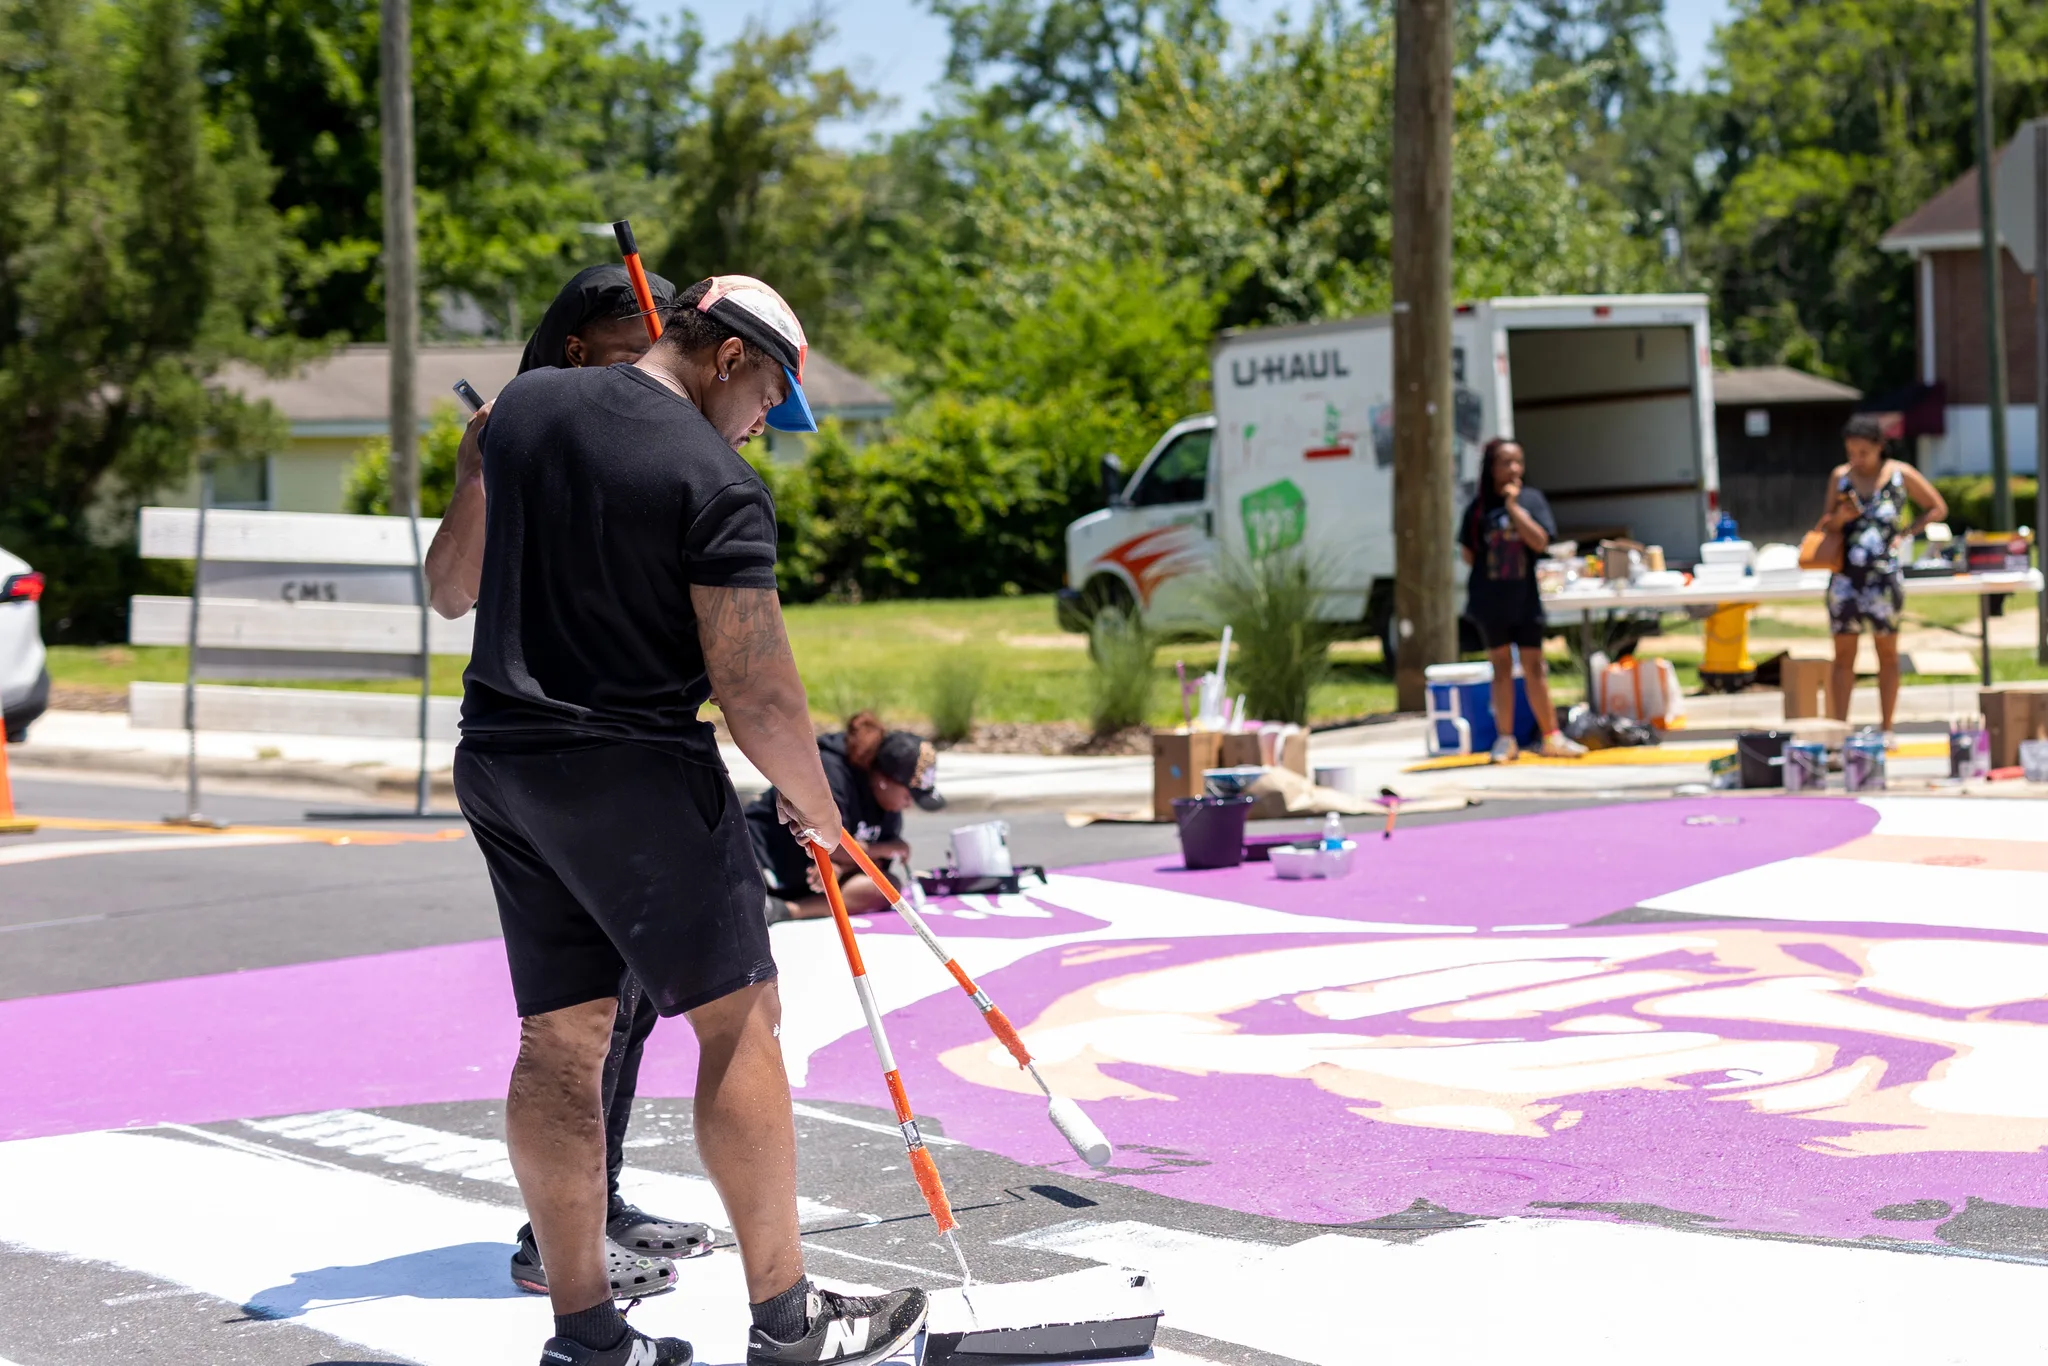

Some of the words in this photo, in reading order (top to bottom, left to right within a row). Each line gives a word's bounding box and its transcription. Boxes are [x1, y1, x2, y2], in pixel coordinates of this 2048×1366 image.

[281, 581, 338, 603] CMS
[818, 1317, 870, 1361] N
[548, 1350, 573, 1362] balance
